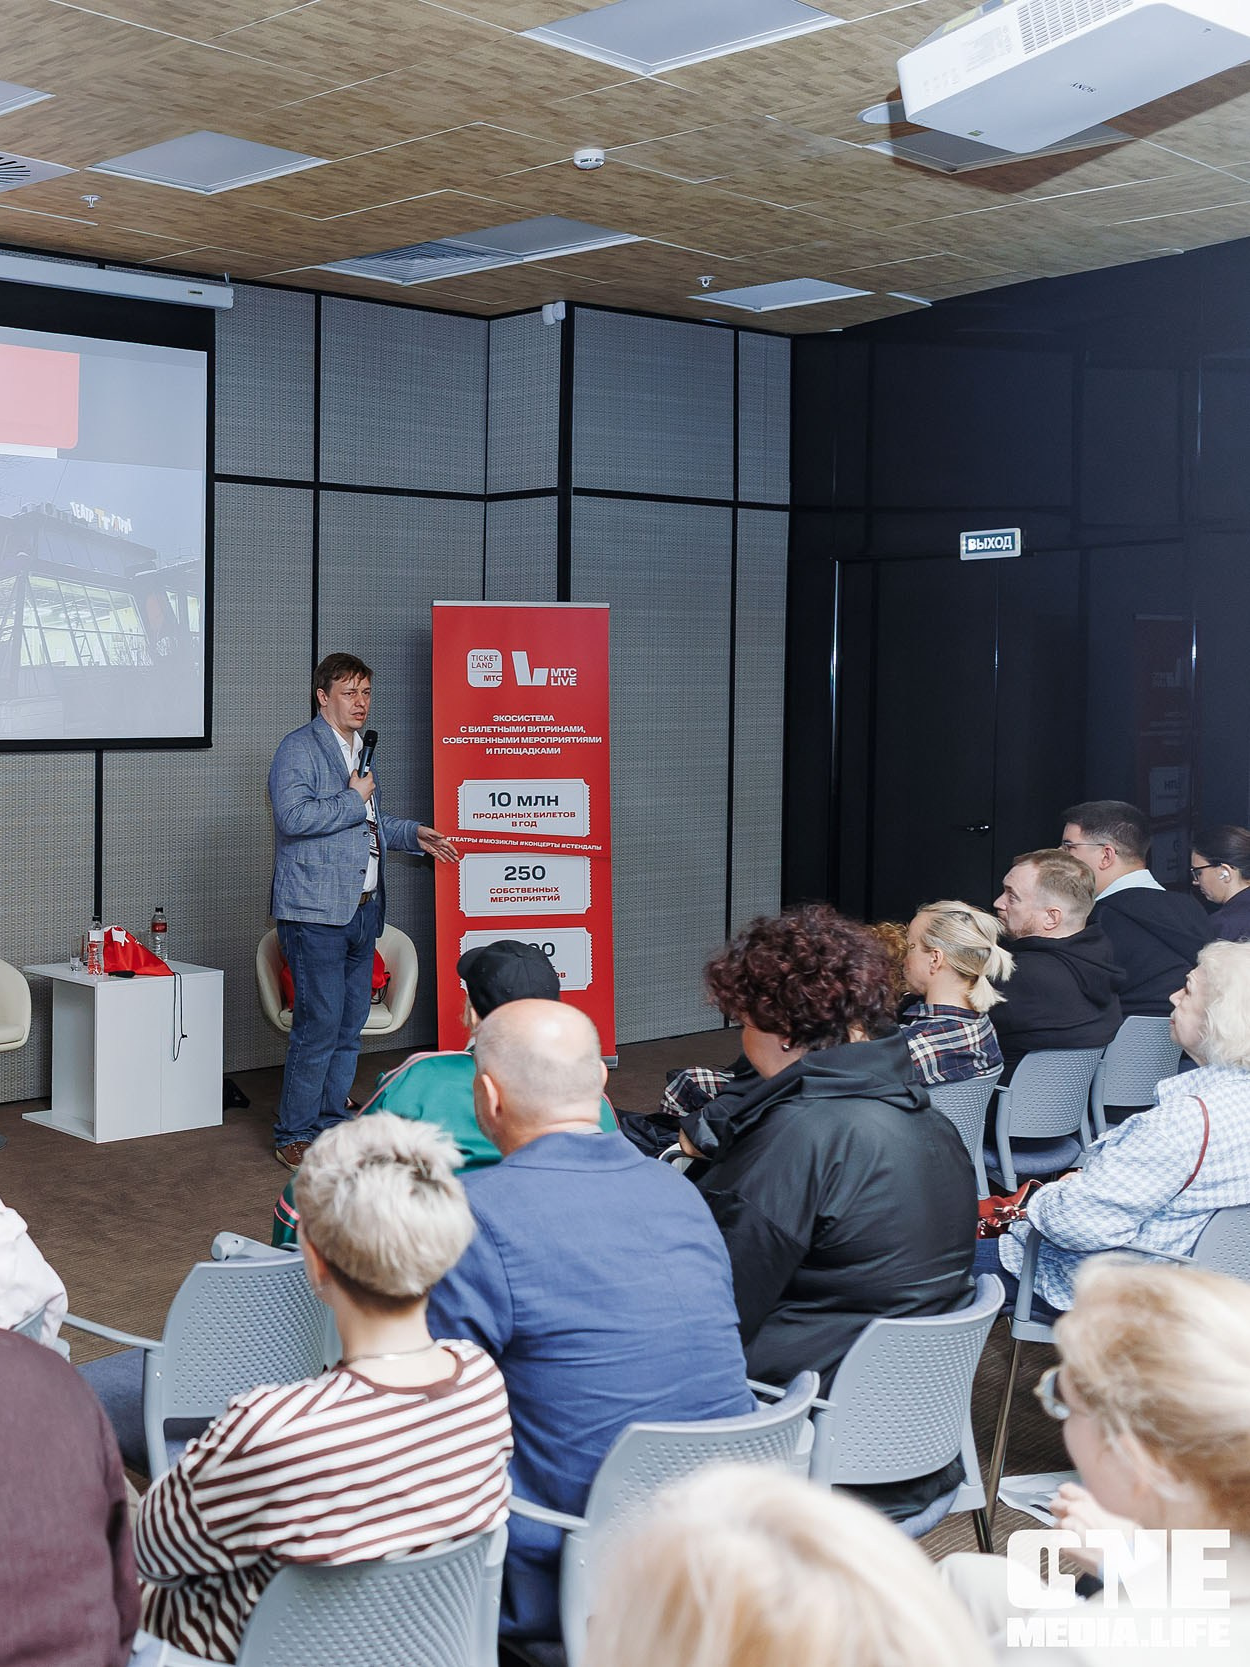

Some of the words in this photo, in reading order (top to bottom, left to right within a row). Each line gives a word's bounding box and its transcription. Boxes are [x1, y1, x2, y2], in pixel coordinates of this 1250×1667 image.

[967, 536, 1013, 551] ВЫХОД
[471, 654, 498, 662] TICKET
[551, 677, 577, 686] LIVE
[493, 714, 555, 722] ЭКОСИСТЕМА
[527, 726, 586, 734] ВИТРИНАМИ,
[486, 747, 493, 755] И
[493, 747, 561, 756] ПЛОЩАДКАМИ
[488, 792, 512, 807] 10
[518, 820, 538, 828] ГОД
[504, 865, 546, 881] 250
[489, 886, 559, 894] СОБСТВЕННЫХ
[490, 894, 561, 903] МЕРОПРИЯТИЙ
